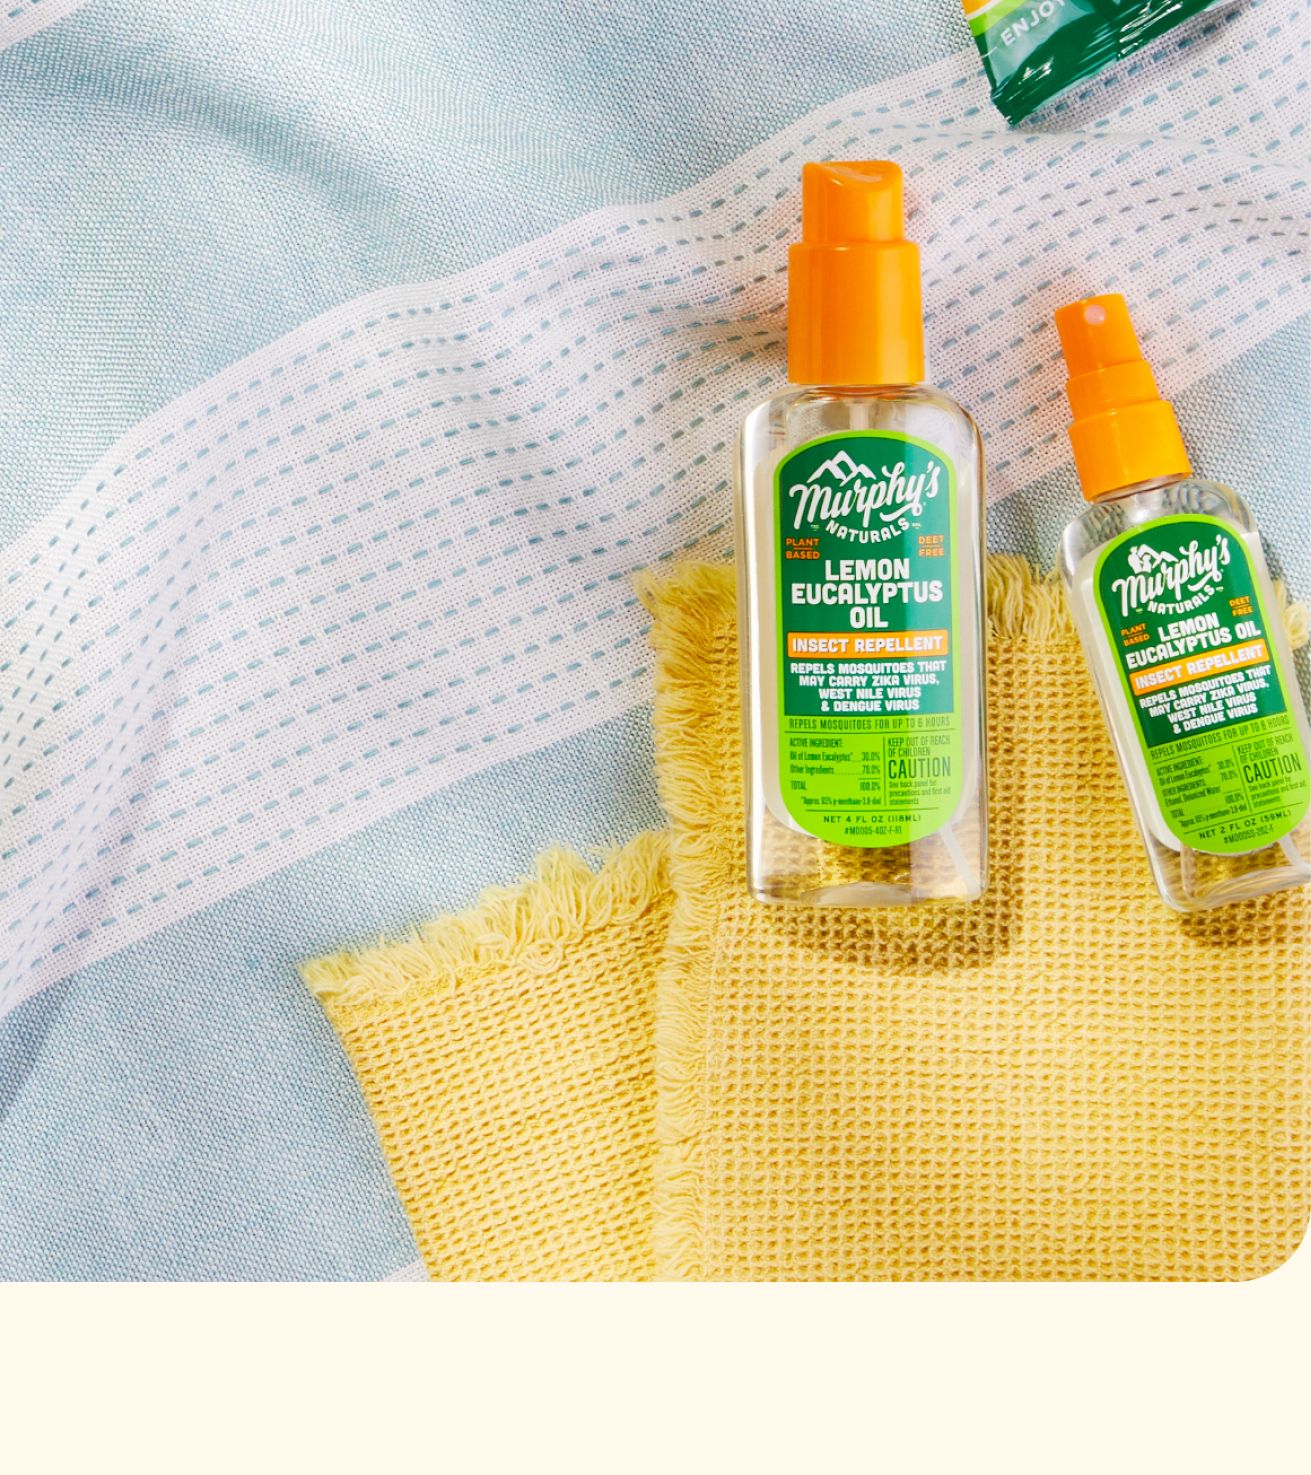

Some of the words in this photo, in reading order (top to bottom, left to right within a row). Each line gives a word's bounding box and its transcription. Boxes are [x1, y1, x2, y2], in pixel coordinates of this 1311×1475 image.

[789, 461, 941, 530] Murphy's
[825, 518, 909, 543] NATURALS
[918, 535, 944, 544] DEET
[786, 538, 819, 546] PLANT
[918, 549, 944, 557] FREE
[786, 551, 820, 559] BASED
[825, 559, 910, 581] LEMON
[1112, 535, 1230, 617] Murphy's
[791, 580, 943, 605] EUCALYPTUS
[1148, 585, 1215, 614] NATURALS
[850, 606, 888, 629] OIL
[1158, 613, 1220, 642] LEMON
[792, 638, 849, 651] INSECT
[854, 636, 943, 652] REPELLENT
[1126, 627, 1232, 669] EUCALYPTUS
[1236, 621, 1261, 638] OIL
[790, 663, 834, 673] REPELS
[838, 663, 914, 673] MOSQUITOES
[917, 661, 946, 671] THAT
[1135, 666, 1182, 690] INSECT
[1188, 645, 1263, 676] REPELLENT
[799, 676, 824, 685] MAY
[828, 675, 867, 686] CARRY
[872, 675, 899, 685] ZIKA
[903, 673, 939, 685] VIRUS,
[1140, 689, 1177, 709] REPELS
[1179, 672, 1245, 697] MOSQUITOES
[1246, 665, 1271, 677] THAT
[818, 688, 852, 698] WEST
[856, 688, 883, 698] NILE
[886, 687, 921, 697] VIRUS
[1149, 704, 1170, 717] MAY
[1174, 694, 1206, 710] CARRY
[1211, 688, 1235, 700] ZIKA
[1237, 678, 1270, 693] VIRUS,
[820, 701, 829, 711] &
[833, 701, 881, 710] DENGUE
[884, 699, 919, 710] VIRUS
[1168, 710, 1196, 724] WEST
[1200, 702, 1224, 716] NILE
[1227, 693, 1257, 708] VIRUS
[789, 719, 817, 728] REPELS
[820, 719, 871, 728] MOSQUITOES
[875, 718, 889, 728] FOR
[892, 718, 902, 728] UP
[905, 717, 915, 727] TO
[918, 717, 922, 726] 6
[925, 716, 949, 726] HOURS
[1173, 723, 1181, 734] &
[1184, 714, 1225, 731] DENGUE
[1227, 704, 1257, 719] VIRUS
[887, 737, 903, 745] KEEP
[906, 737, 918, 745] OUT
[921, 736, 929, 745] OF
[888, 748, 895, 757] OF
[898, 747, 930, 756] CHILDREN
[888, 757, 950, 778] CAUTION
[1243, 752, 1301, 783] CAUTION
